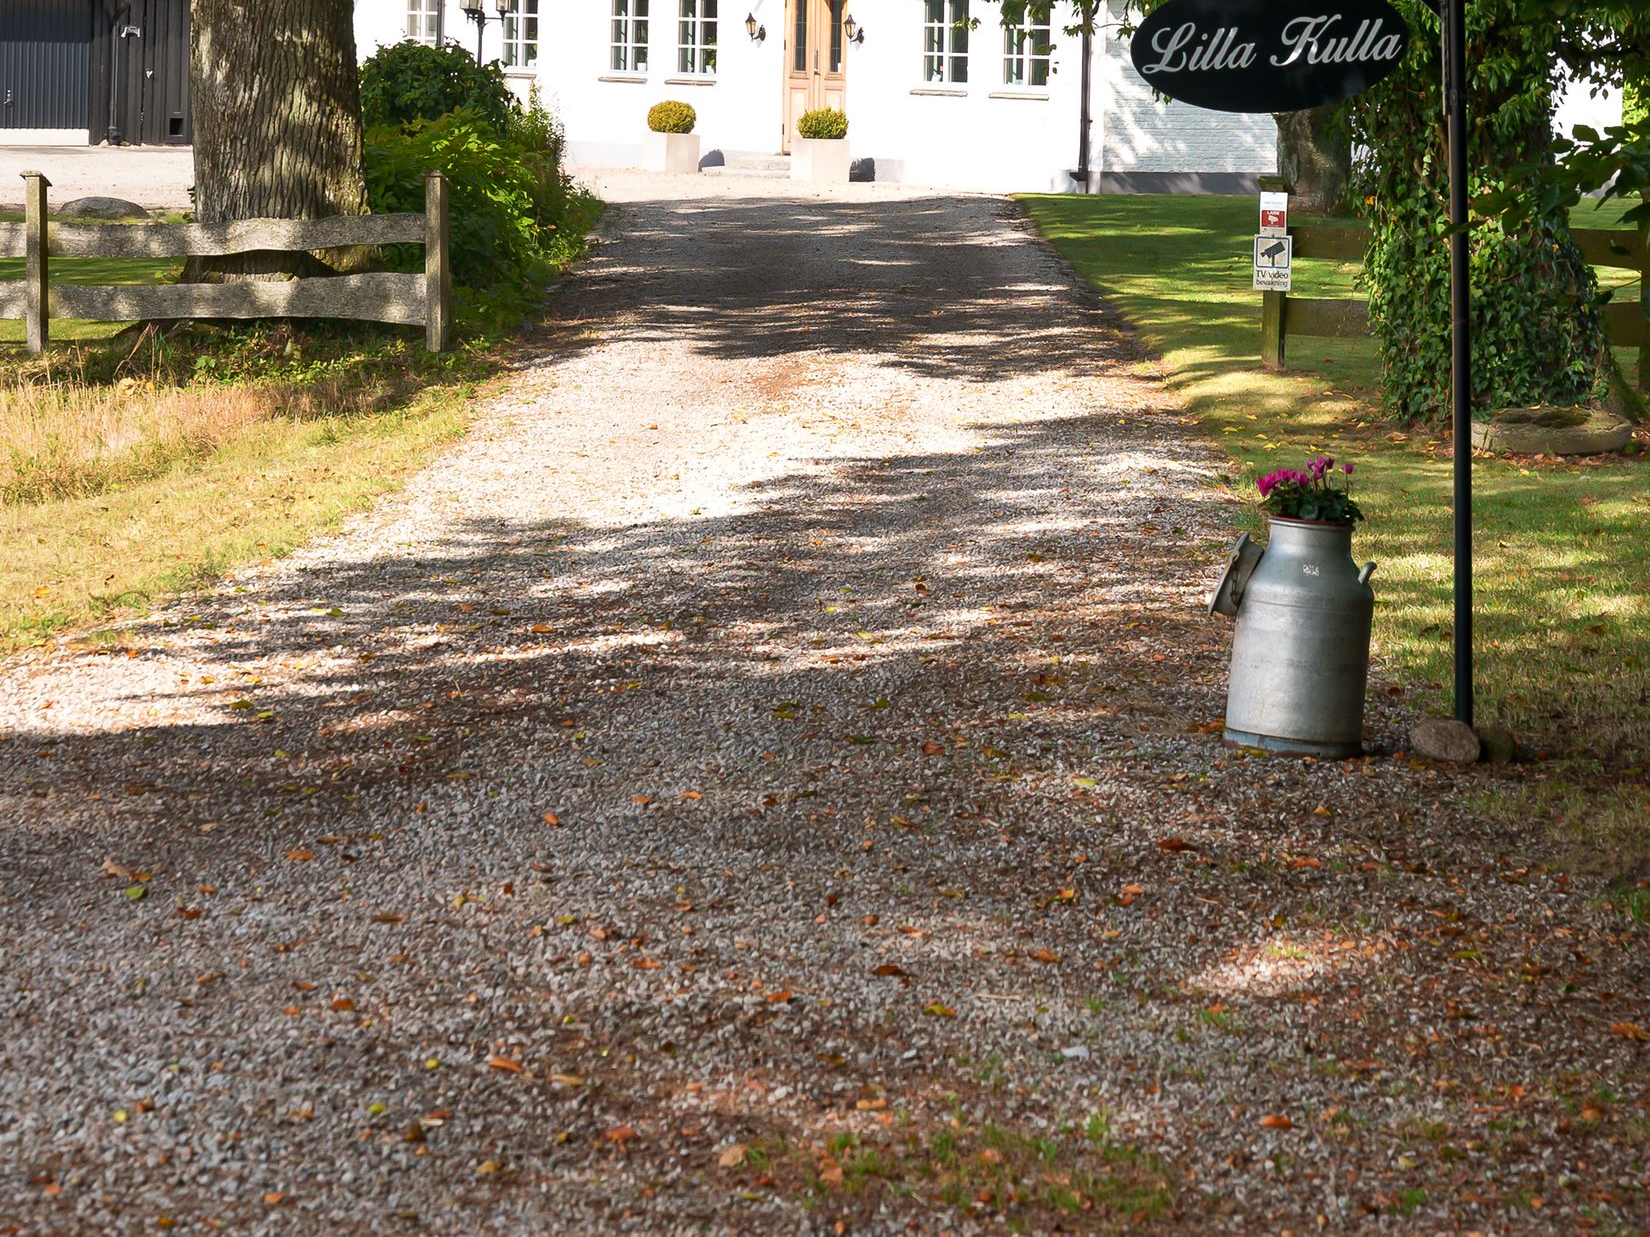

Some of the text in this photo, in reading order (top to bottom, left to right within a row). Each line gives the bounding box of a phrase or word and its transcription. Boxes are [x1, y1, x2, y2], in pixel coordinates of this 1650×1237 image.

[1142, 14, 1402, 74] Lilla Kulla
[1256, 270, 1288, 279] TV video
[1256, 279, 1288, 288] bevakning
